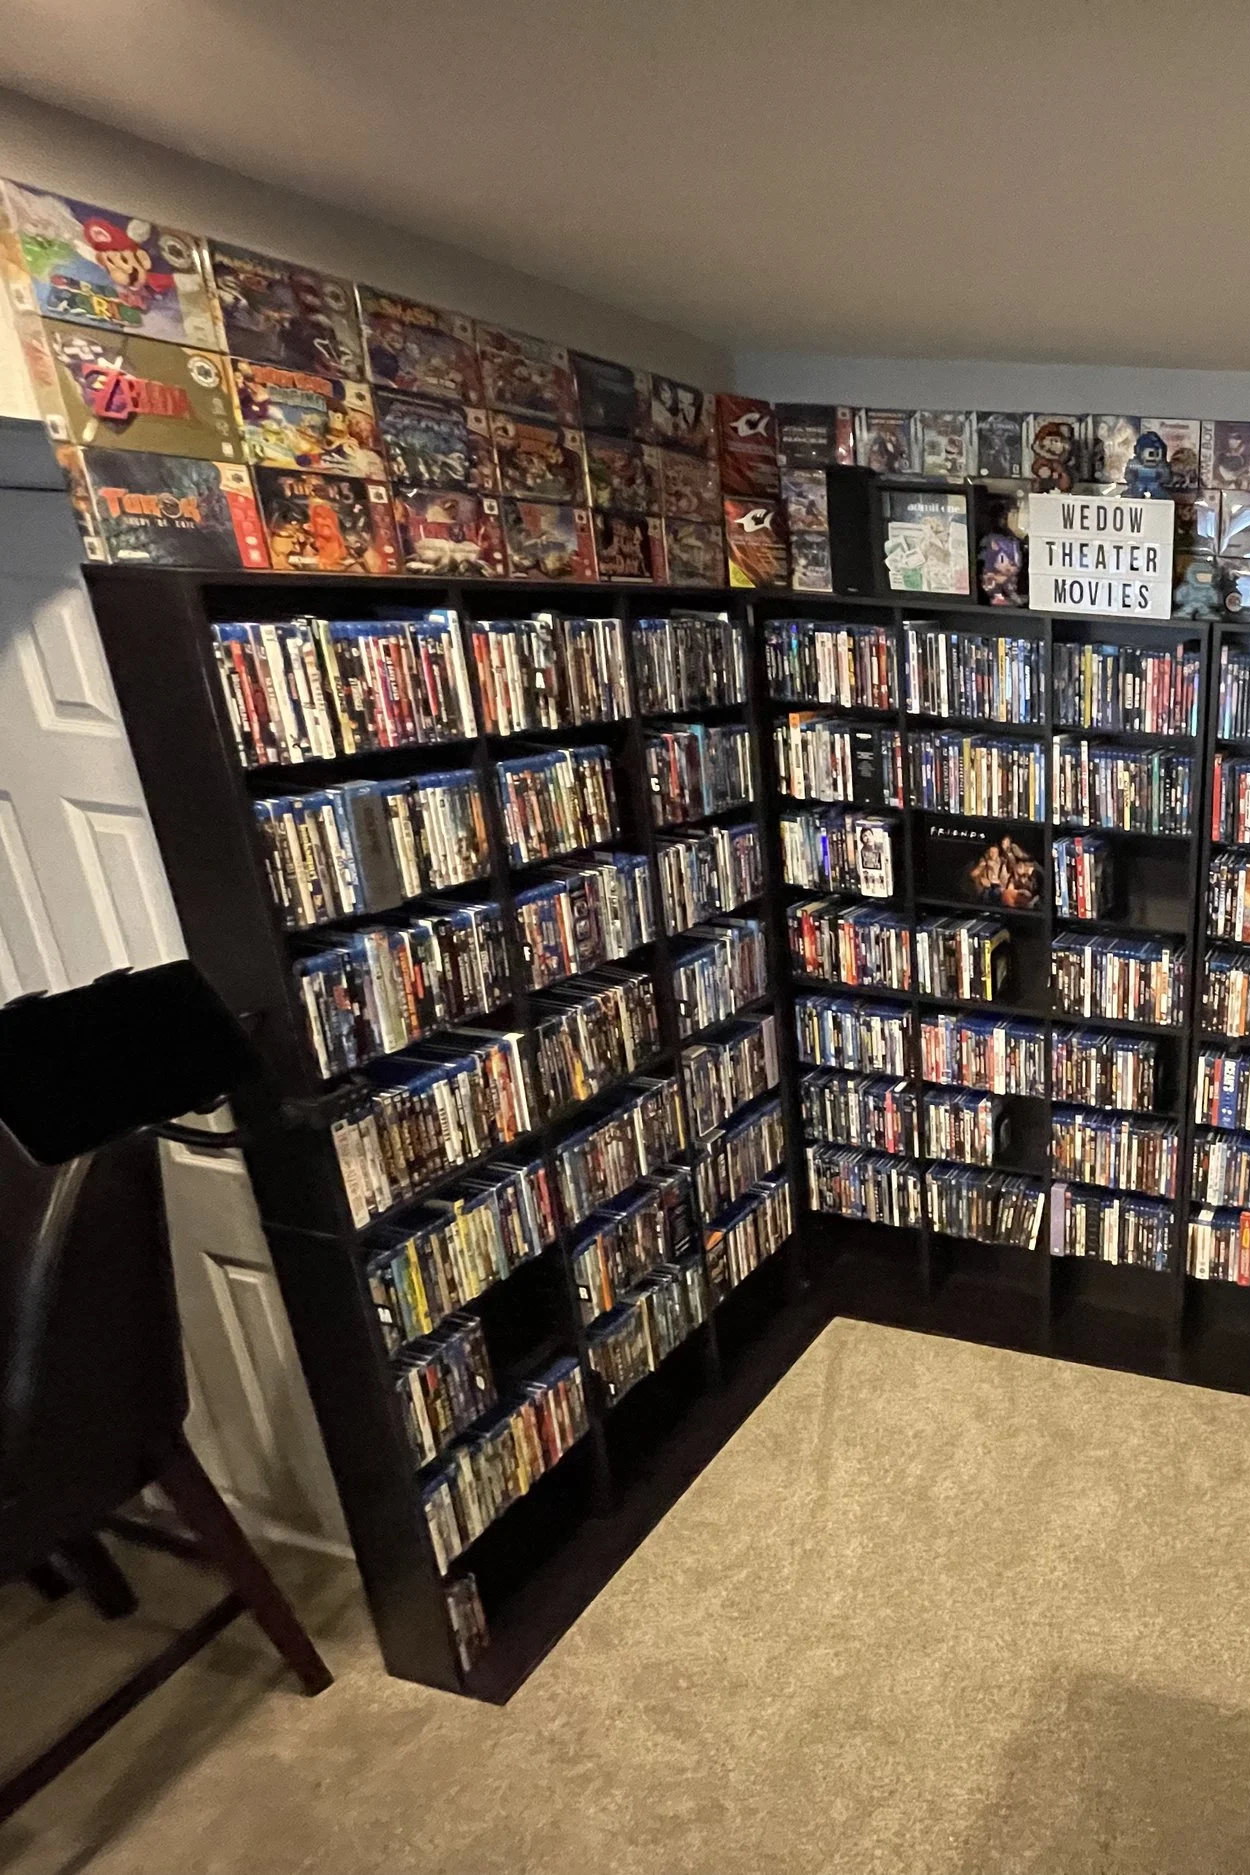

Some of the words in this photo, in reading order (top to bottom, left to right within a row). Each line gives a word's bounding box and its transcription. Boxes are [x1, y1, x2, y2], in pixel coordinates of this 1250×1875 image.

[1061, 503, 1143, 533] WEDOW
[1045, 541, 1158, 573] THEATER
[1054, 579, 1150, 609] MOVIES
[930, 826, 986, 839] FRIENDS
